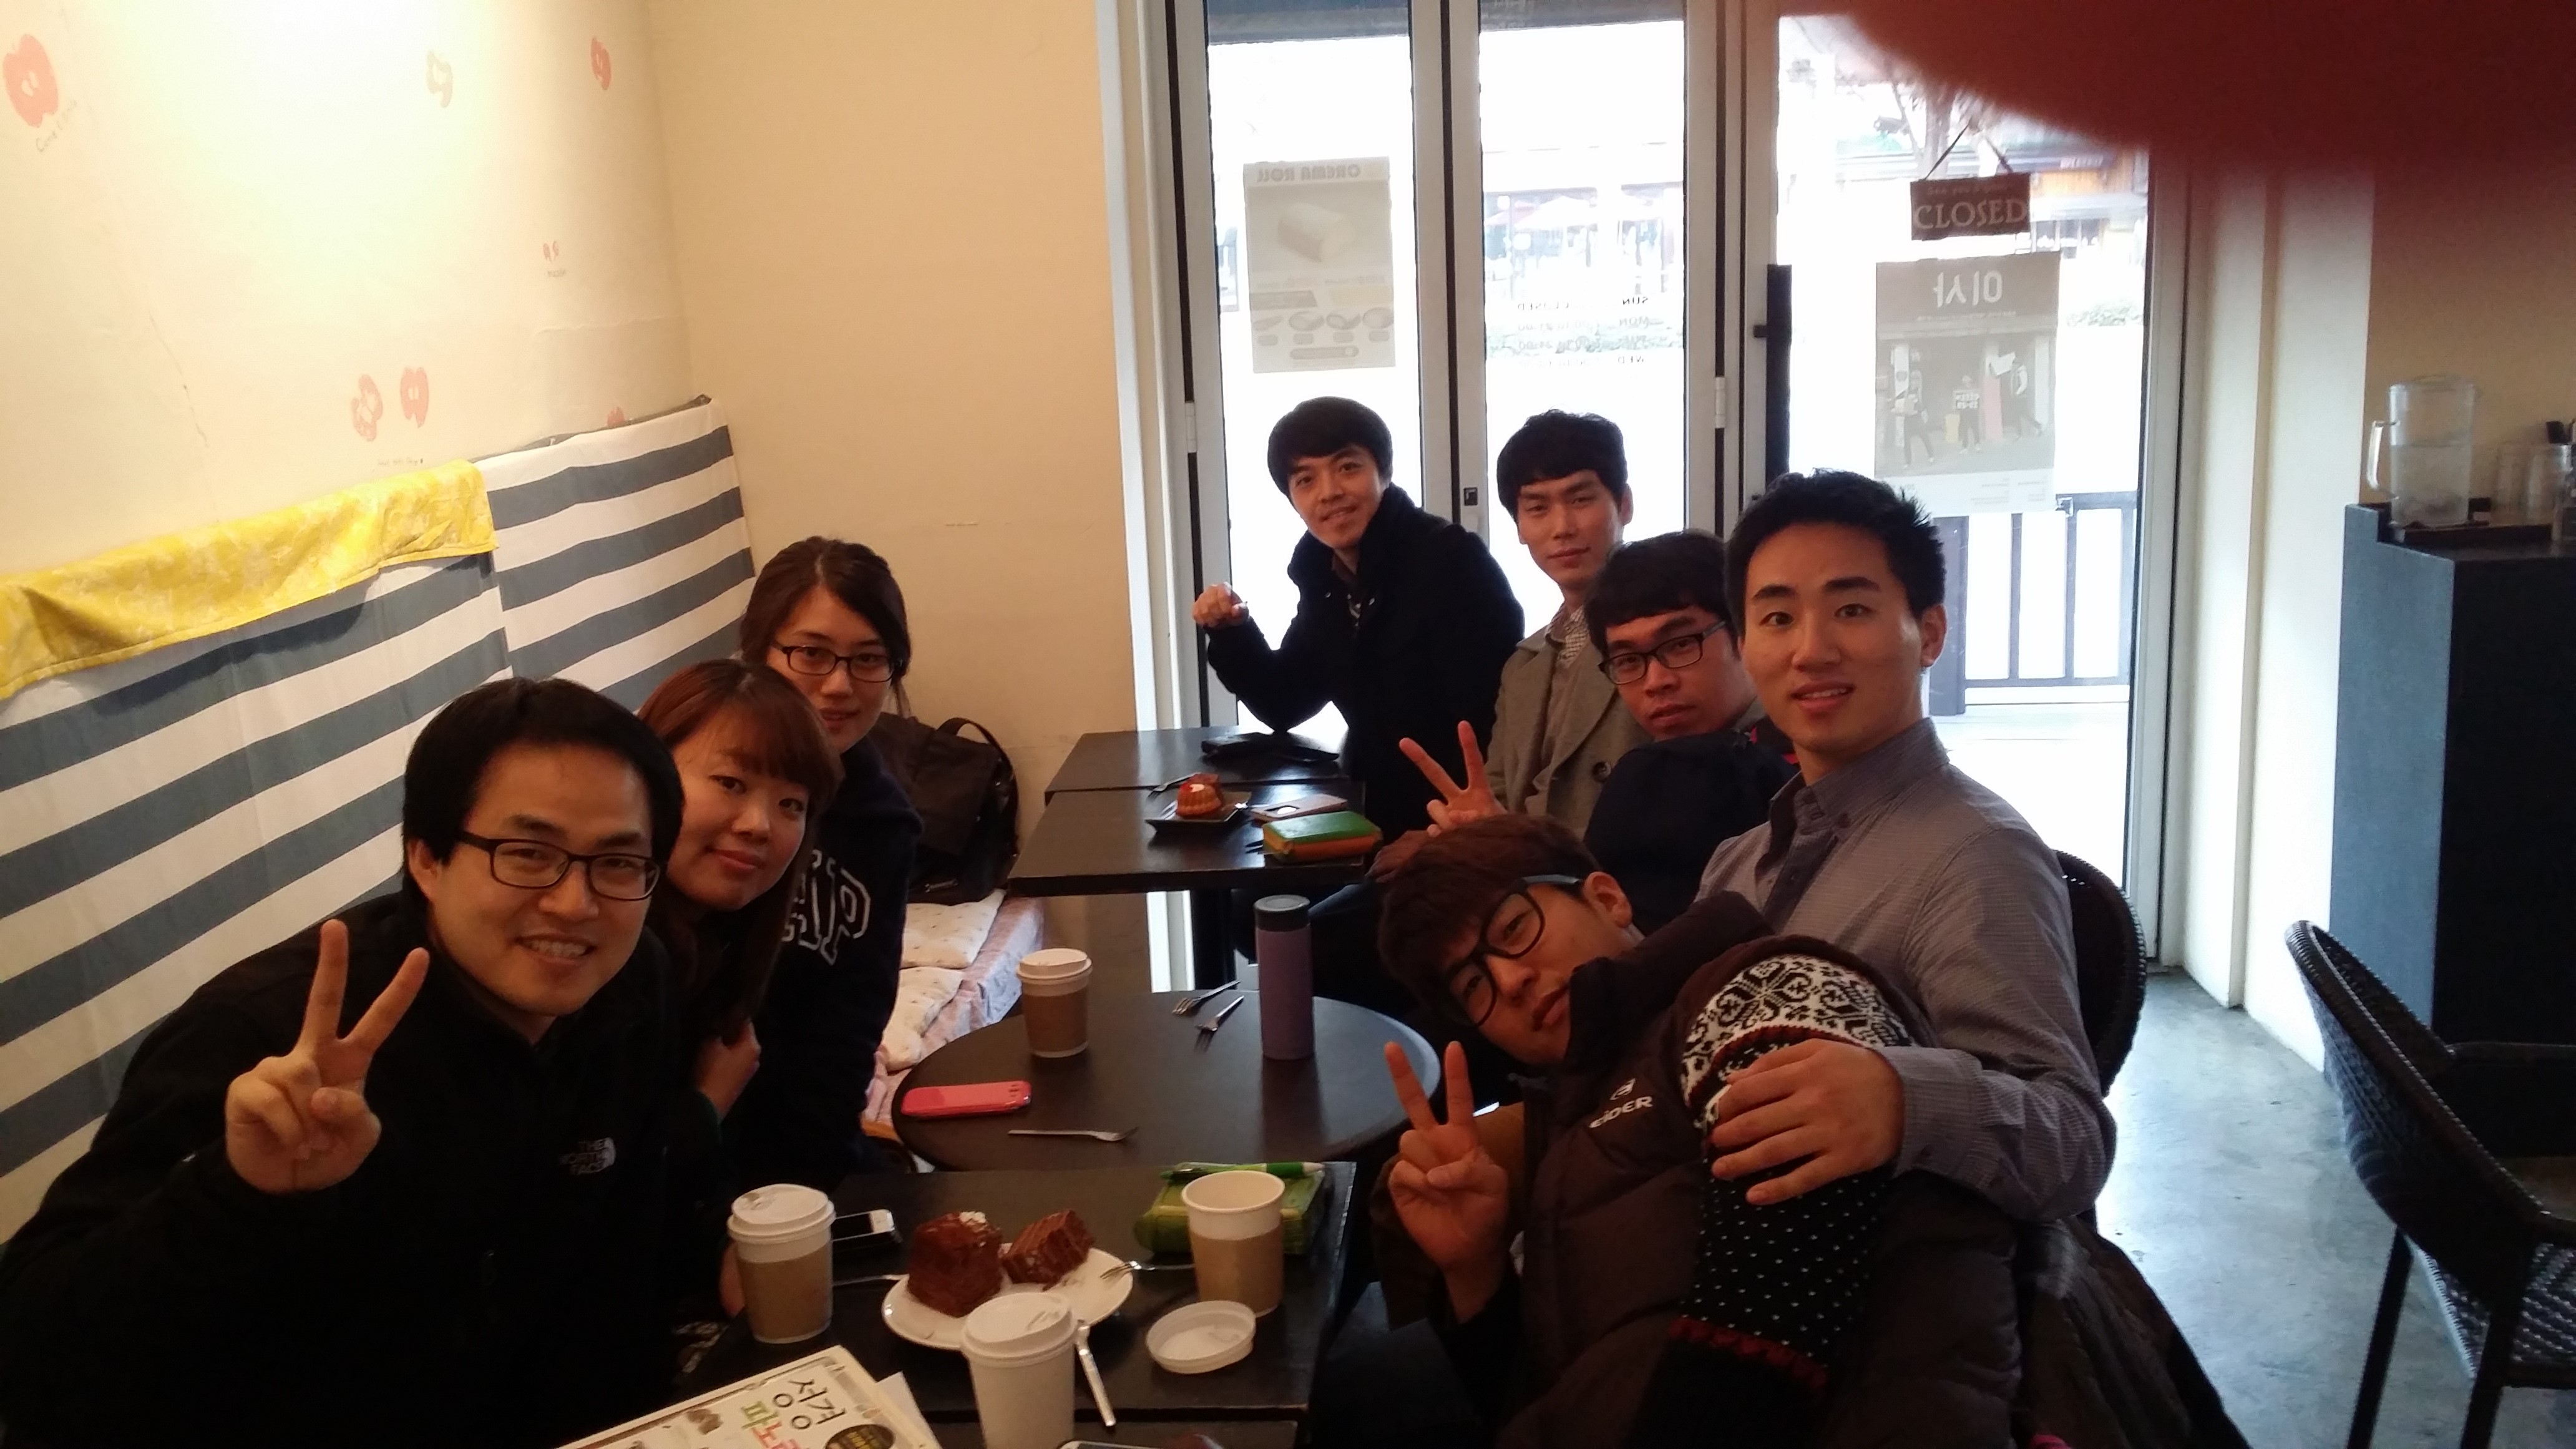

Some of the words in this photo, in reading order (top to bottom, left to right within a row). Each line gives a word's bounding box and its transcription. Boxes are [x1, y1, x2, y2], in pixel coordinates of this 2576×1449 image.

[1913, 198, 2028, 229] CLOSED
[781, 849, 871, 965] AP
[577, 1139, 604, 1152] THE
[559, 1151, 606, 1166] NORTH
[570, 1161, 603, 1175] FACE
[773, 1378, 846, 1430] 성경
